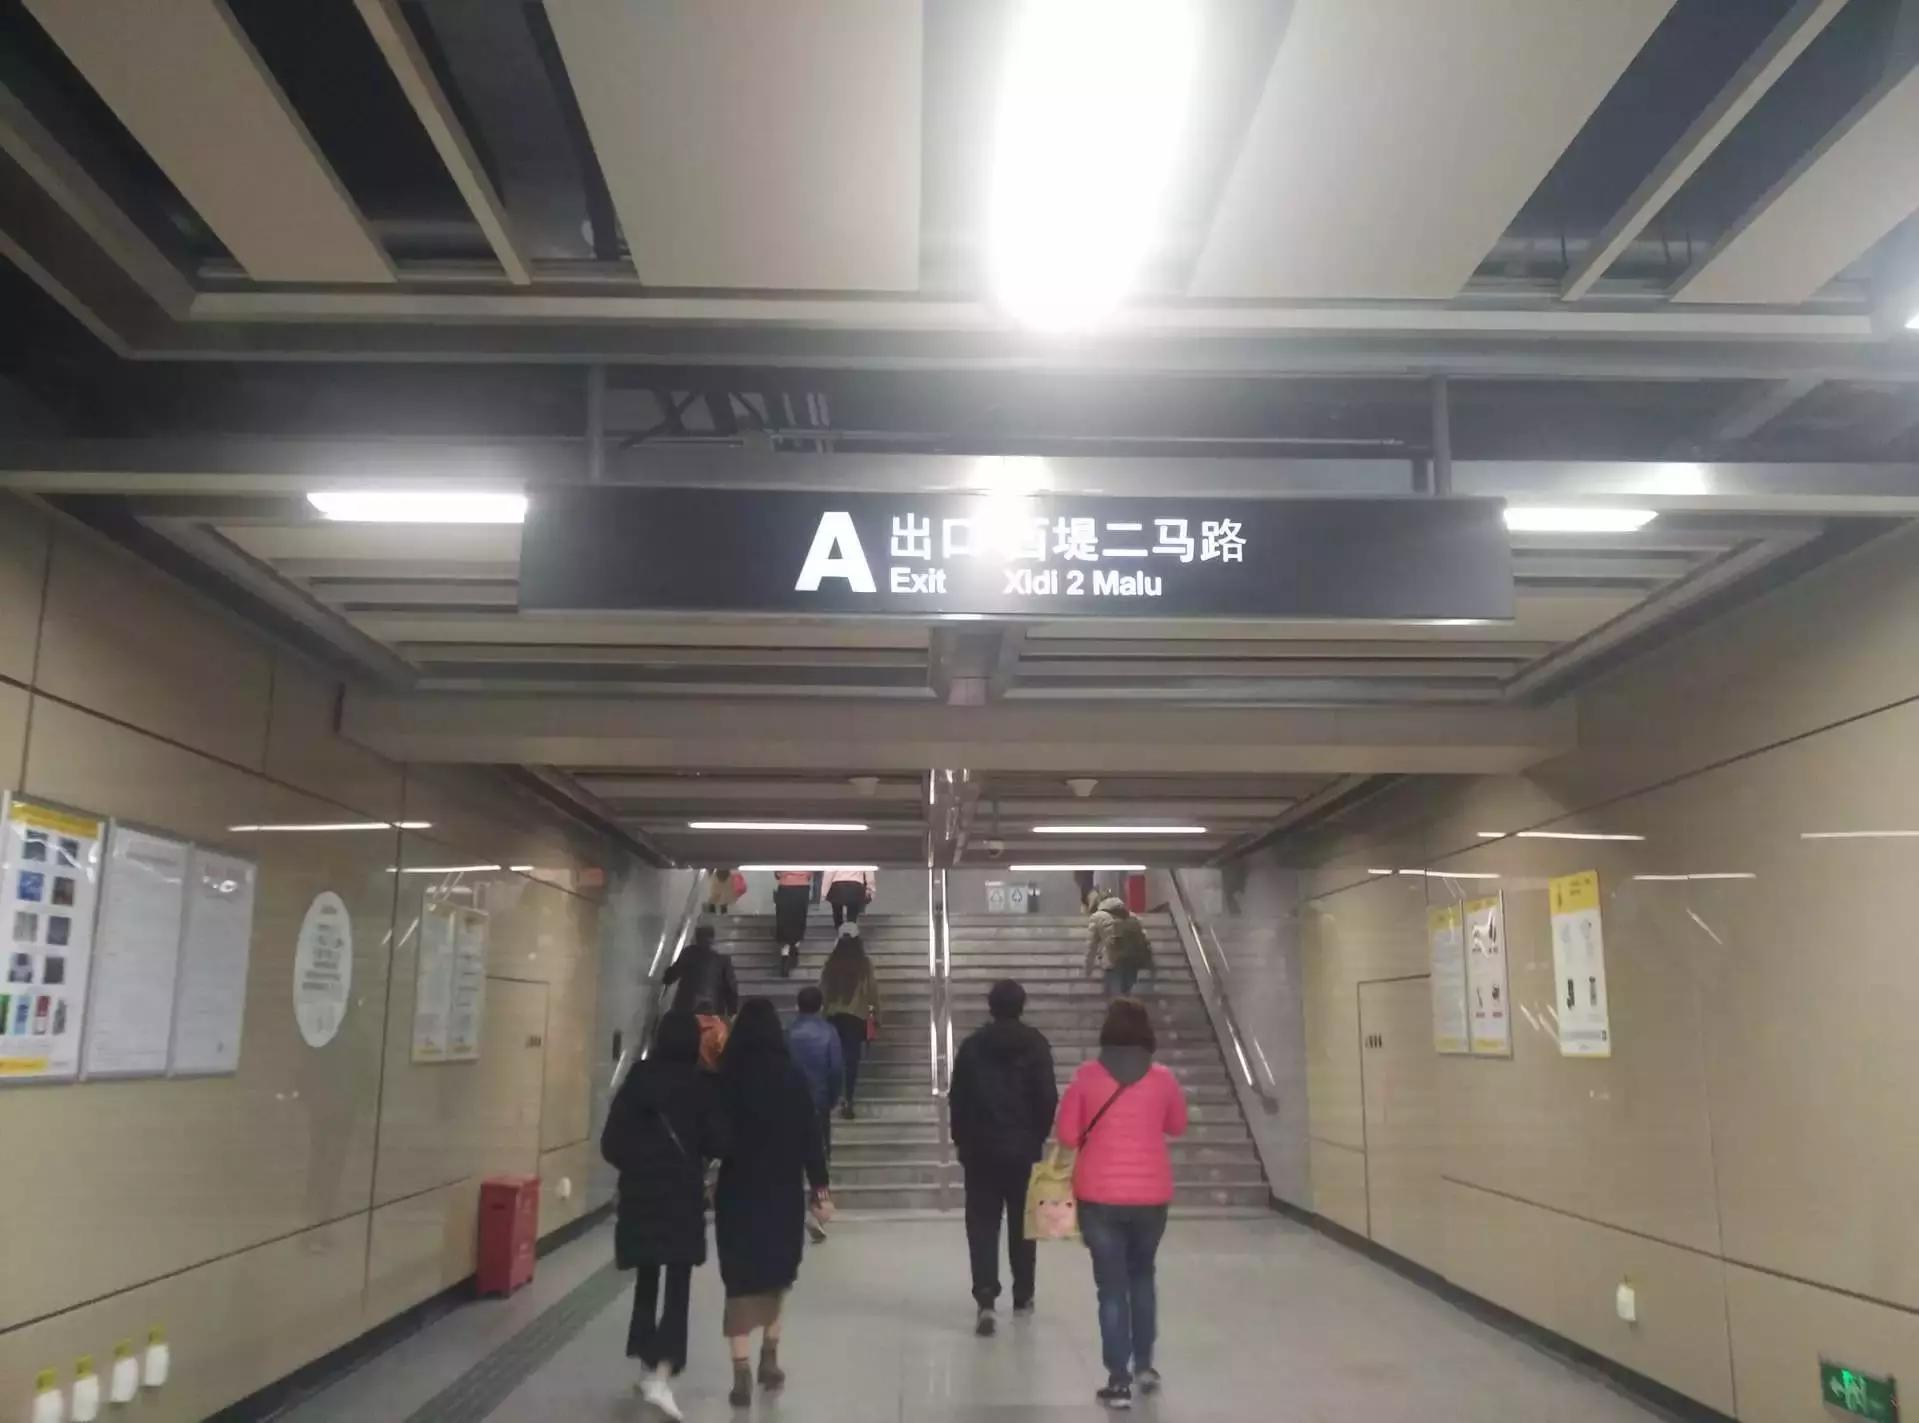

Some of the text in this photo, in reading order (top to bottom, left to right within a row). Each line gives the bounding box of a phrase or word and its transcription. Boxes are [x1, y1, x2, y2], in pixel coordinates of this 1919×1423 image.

[795, 511, 876, 592] A
[891, 513, 979, 561] 出口
[890, 567, 1162, 597] Exit Xidi 2 Malu
